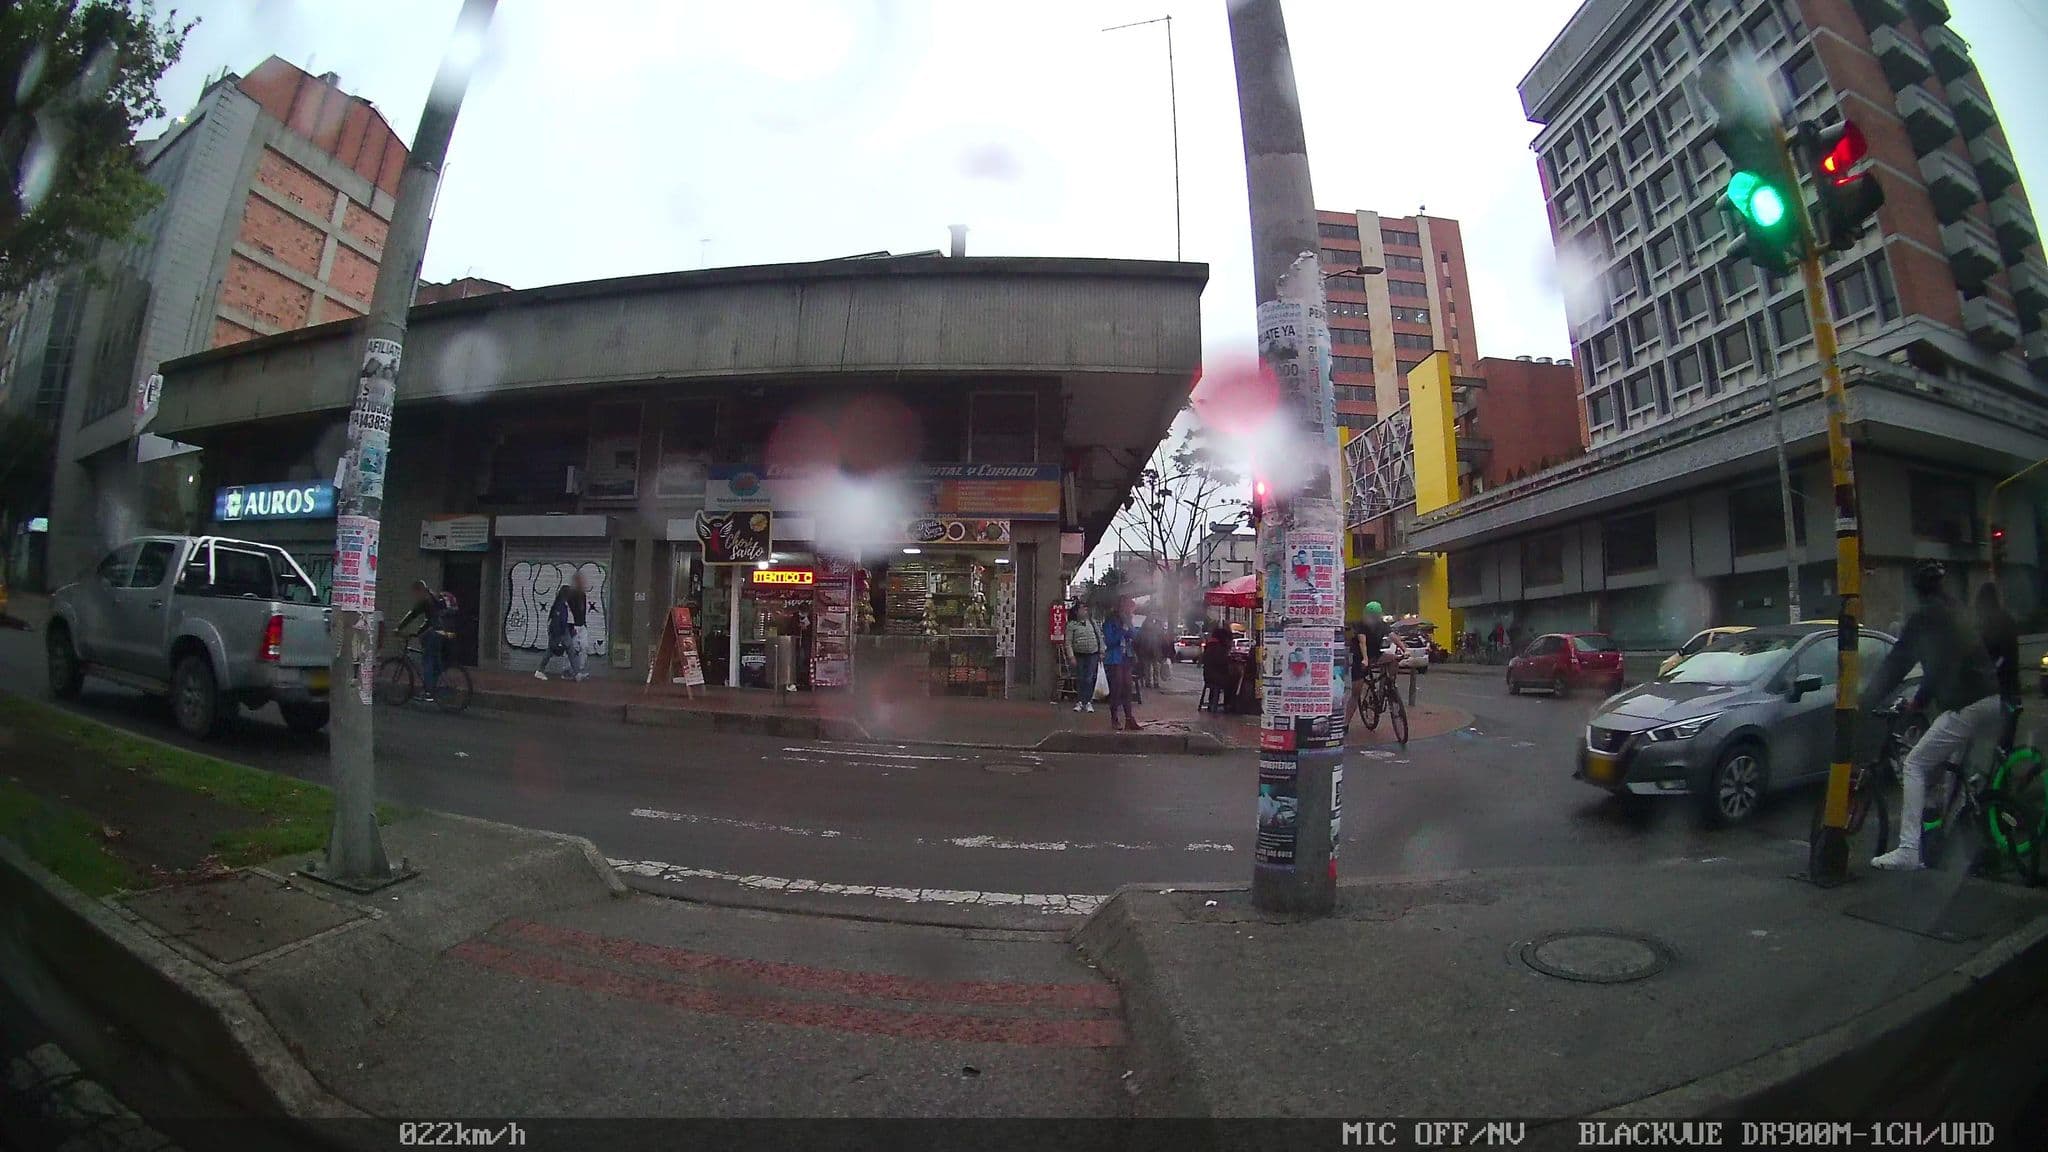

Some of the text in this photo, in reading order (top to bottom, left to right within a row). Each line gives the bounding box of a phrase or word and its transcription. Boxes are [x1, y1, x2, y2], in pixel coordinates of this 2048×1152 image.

[1282, 325, 1296, 337] YA
[245, 488, 315, 515] AUROS
[730, 541, 763, 561] Santo
